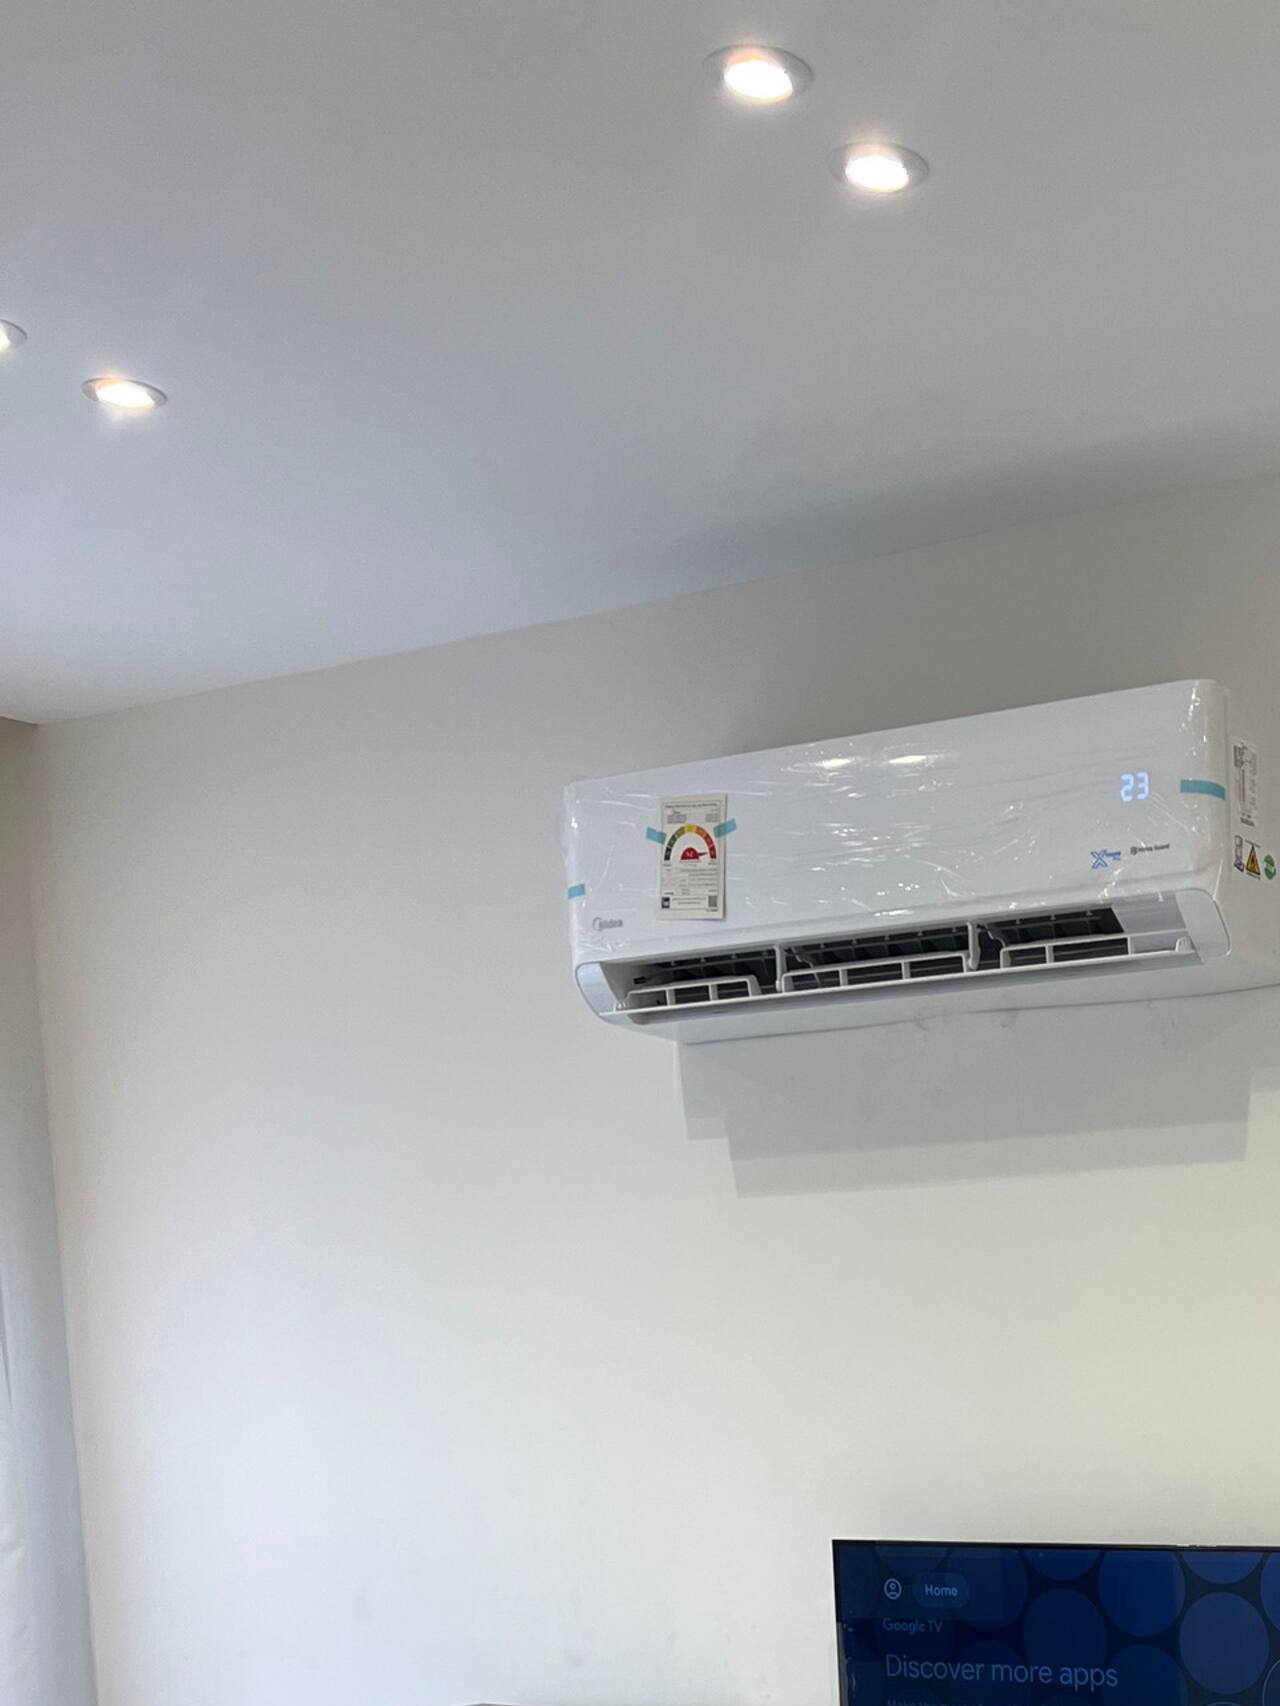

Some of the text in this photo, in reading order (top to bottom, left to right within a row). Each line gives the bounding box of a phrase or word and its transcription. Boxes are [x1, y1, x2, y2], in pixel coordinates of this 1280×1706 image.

[1120, 771, 1149, 802] 23
[924, 1584, 958, 1597] Home
[882, 1617, 943, 1635] Google TV
[885, 1653, 1119, 1692] Discover more apps
